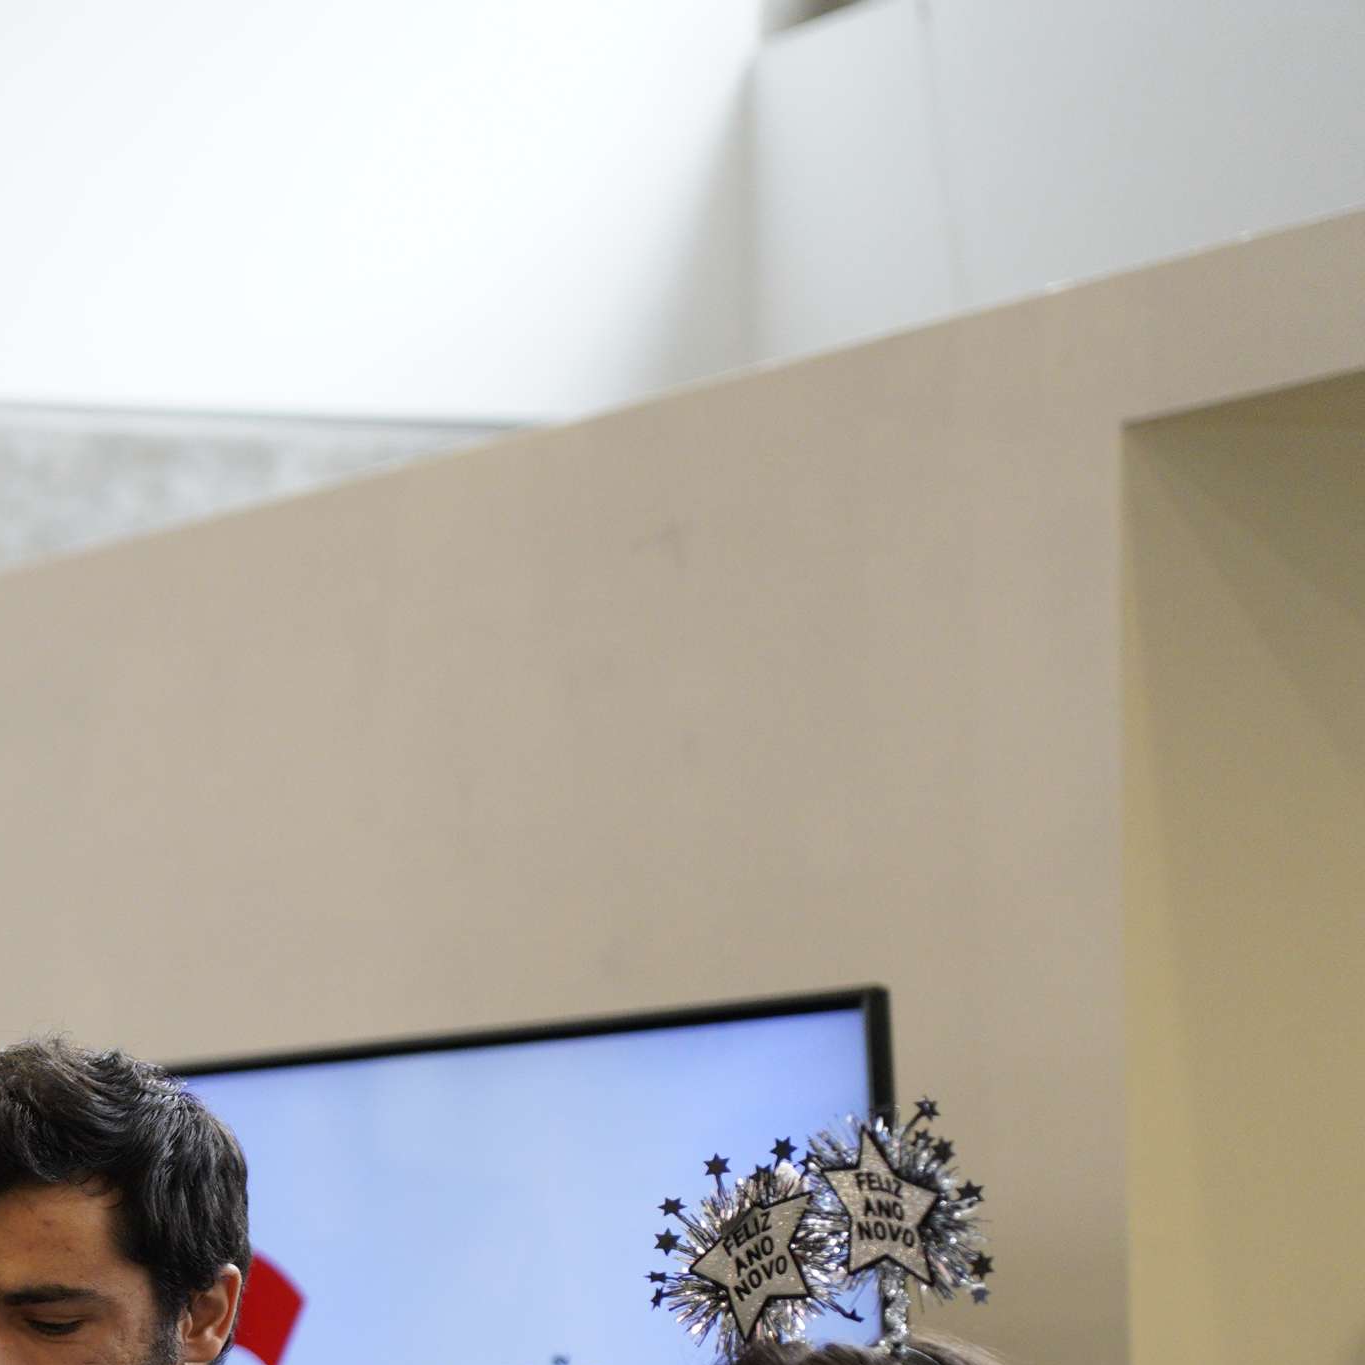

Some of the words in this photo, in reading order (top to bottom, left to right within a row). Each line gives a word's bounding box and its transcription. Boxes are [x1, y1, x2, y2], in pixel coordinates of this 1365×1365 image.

[855, 1171, 904, 1199] FELIZ
[864, 1199, 905, 1221] ANO
[722, 1210, 772, 1256] FELIZ
[857, 1221, 916, 1247] NOVO
[734, 1236, 775, 1277] ANO
[733, 1255, 788, 1302] NOVO
